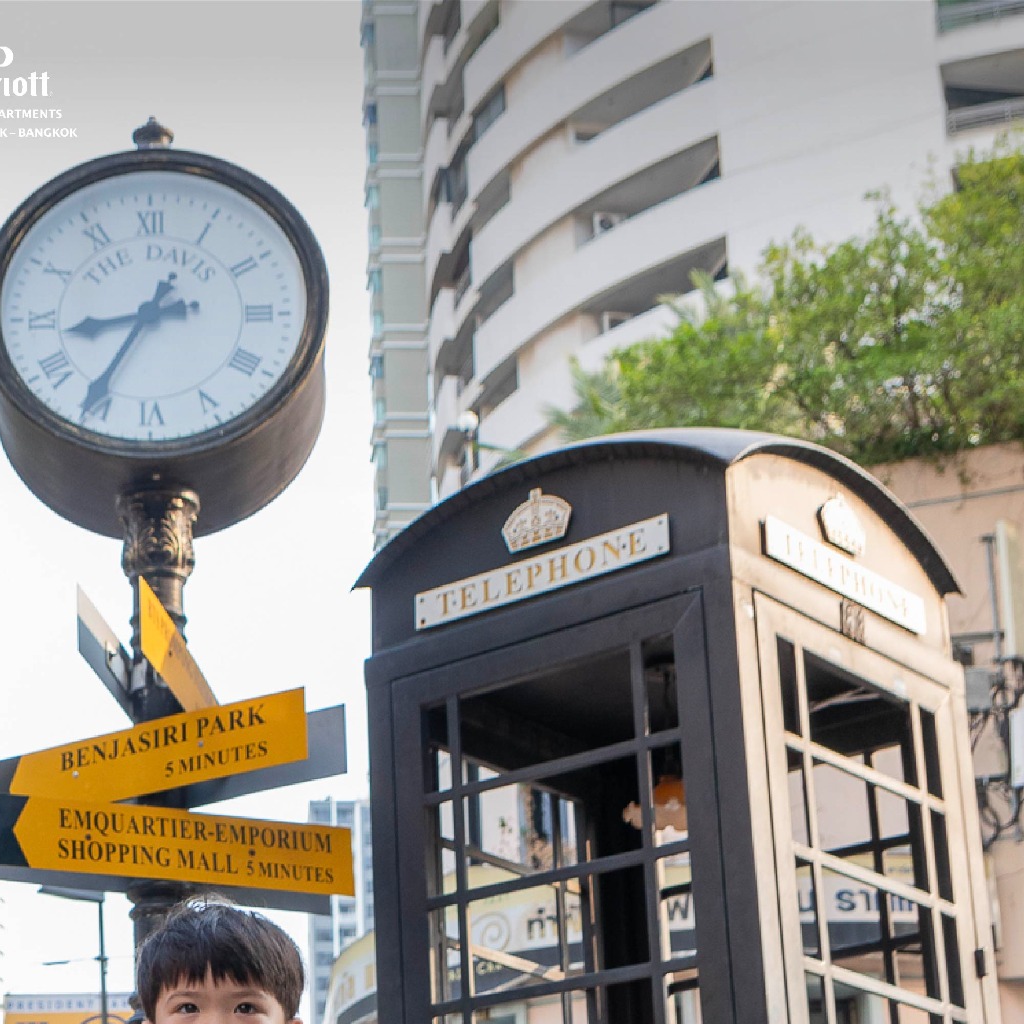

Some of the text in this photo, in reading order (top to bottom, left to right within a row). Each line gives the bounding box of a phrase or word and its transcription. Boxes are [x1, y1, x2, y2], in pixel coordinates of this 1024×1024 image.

[83, 222, 112, 251] XI
[137, 210, 164, 236] XII
[83, 244, 217, 286] THE DAVIS
[28, 308, 56, 331] IX
[139, 401, 165, 426] VI
[436, 527, 649, 616] TELEPHONE
[60, 702, 267, 774] BENJASIRI PARK
[164, 740, 269, 779] 5 MINUTES
[58, 806, 333, 855] EMQUARTIER-EMPORIUM
[57, 837, 335, 885] SHOPPING MALL 5 MINUTES
